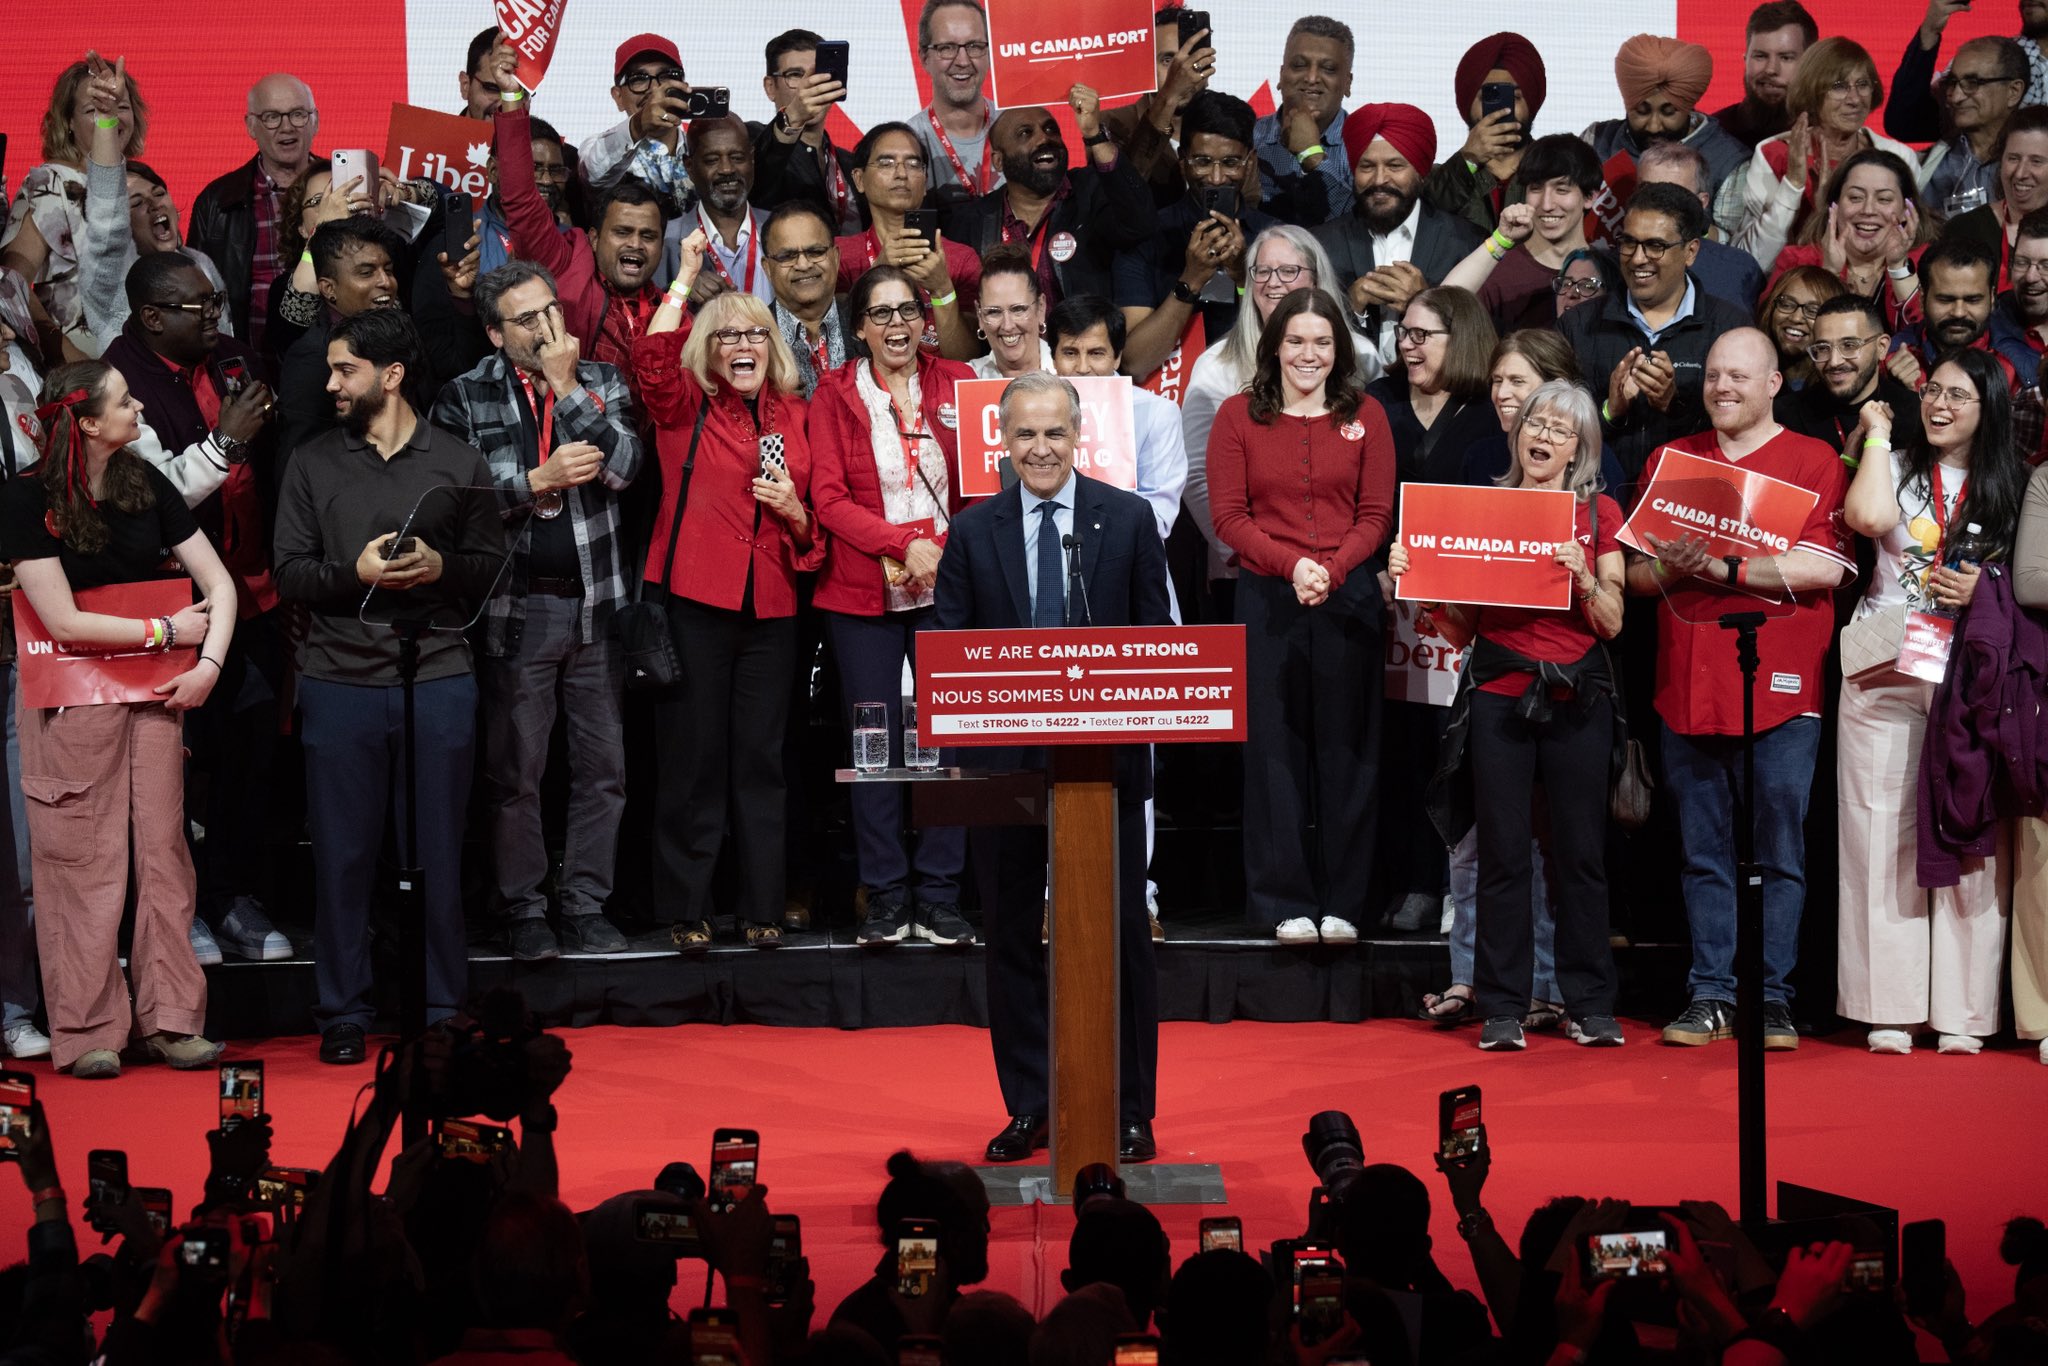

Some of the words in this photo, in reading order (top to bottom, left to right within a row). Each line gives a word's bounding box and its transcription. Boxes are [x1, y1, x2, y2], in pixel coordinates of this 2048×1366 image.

[519, 25, 550, 61] FOR
[999, 42, 1027, 58] UN
[1030, 35, 1105, 55] CANADA
[1107, 28, 1149, 47] FORT
[1652, 498, 1716, 528] CANADA
[1719, 516, 1790, 551] STRONG
[1409, 534, 1436, 549] UN
[1440, 536, 1515, 553] CANADA
[26, 640, 54, 655] UN
[964, 646, 993, 660] WE
[998, 645, 1033, 659] ARE
[1038, 644, 1117, 659] CANADA
[1121, 642, 1199, 657] STRONG
[932, 690, 983, 705] NOUS
[987, 689, 1064, 703] SOMMES
[1069, 688, 1095, 702] UN
[1100, 687, 1179, 701] CANADA
[1184, 686, 1233, 700] FORT
[958, 720, 980, 729] Text
[982, 719, 1029, 729] STRONG
[1031, 719, 1043, 728] to
[1046, 717, 1080, 727] 54222
[1089, 717, 1124, 727] Textez
[1126, 716, 1155, 726] FORT
[1157, 717, 1173, 726] au
[1175, 715, 1210, 725] 54222
